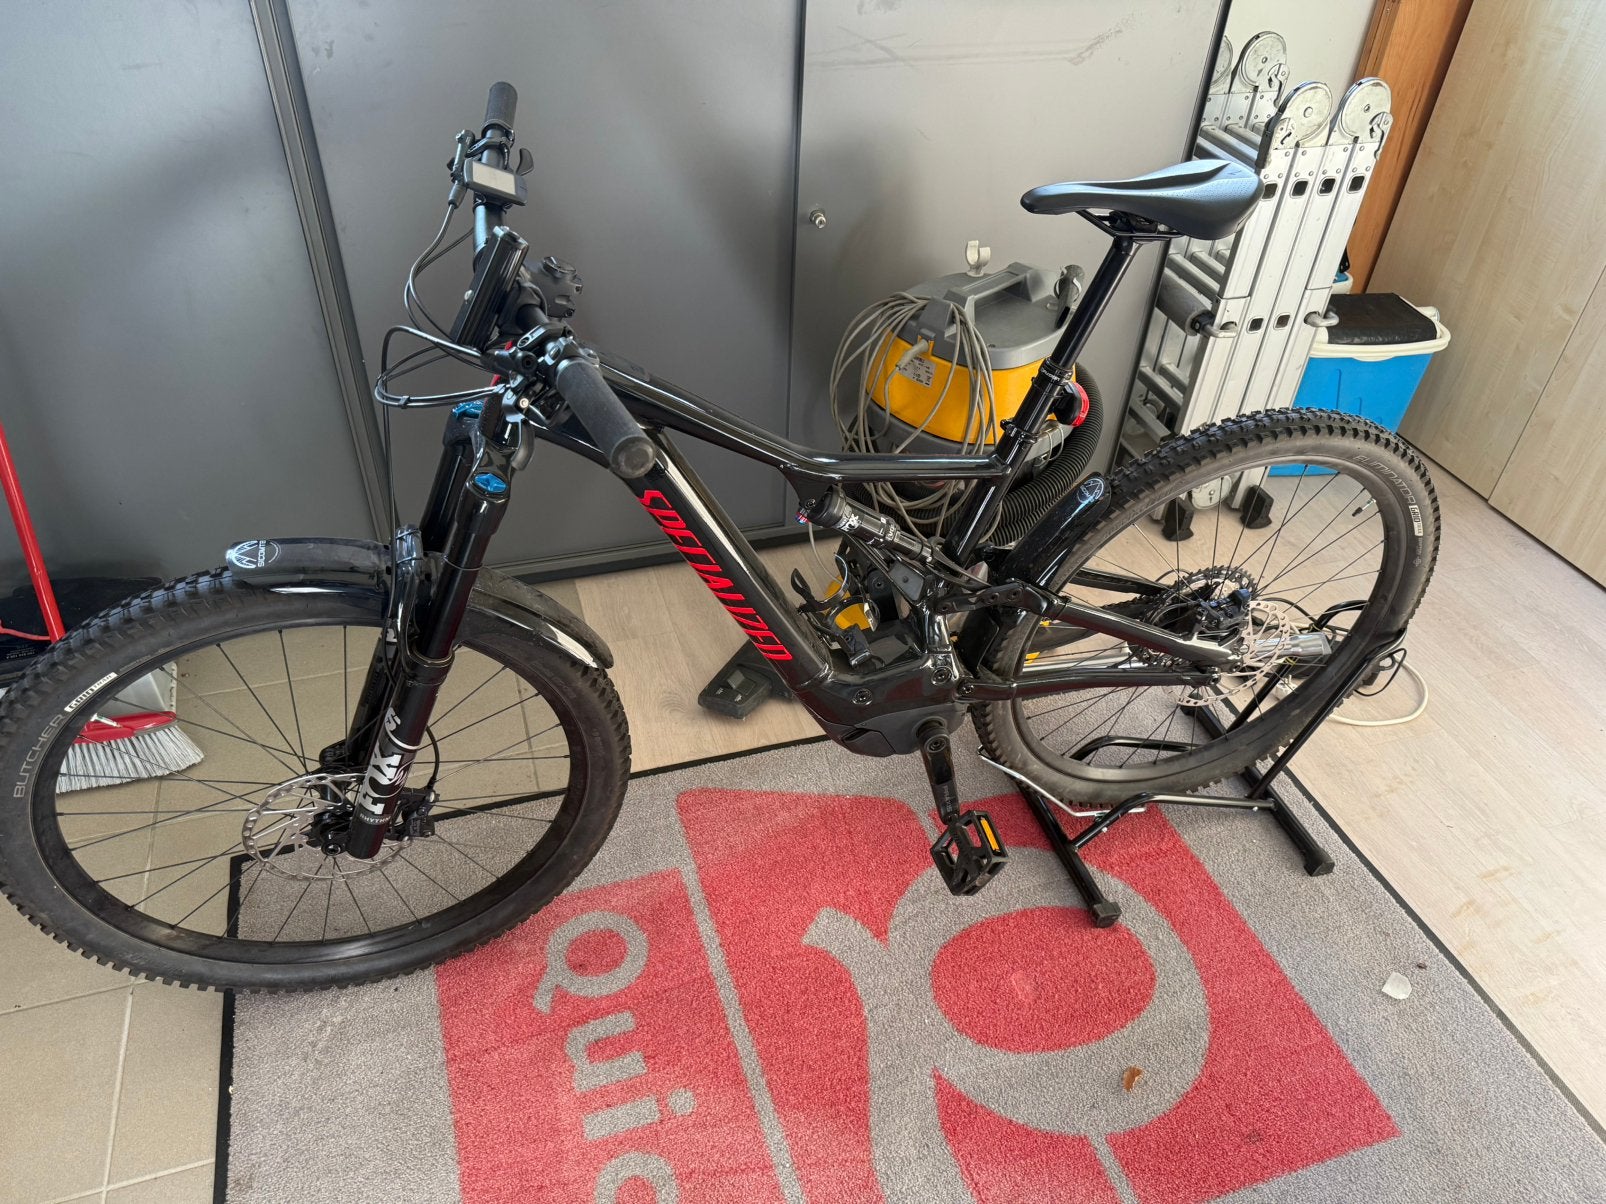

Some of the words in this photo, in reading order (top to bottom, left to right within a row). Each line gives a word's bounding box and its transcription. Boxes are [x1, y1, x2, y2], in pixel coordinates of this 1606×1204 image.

[840, 513, 862, 532] FOX
[637, 490, 793, 660] SPECIALIZED
[13, 714, 66, 798] BUTCHER
[359, 741, 403, 815] FOX
